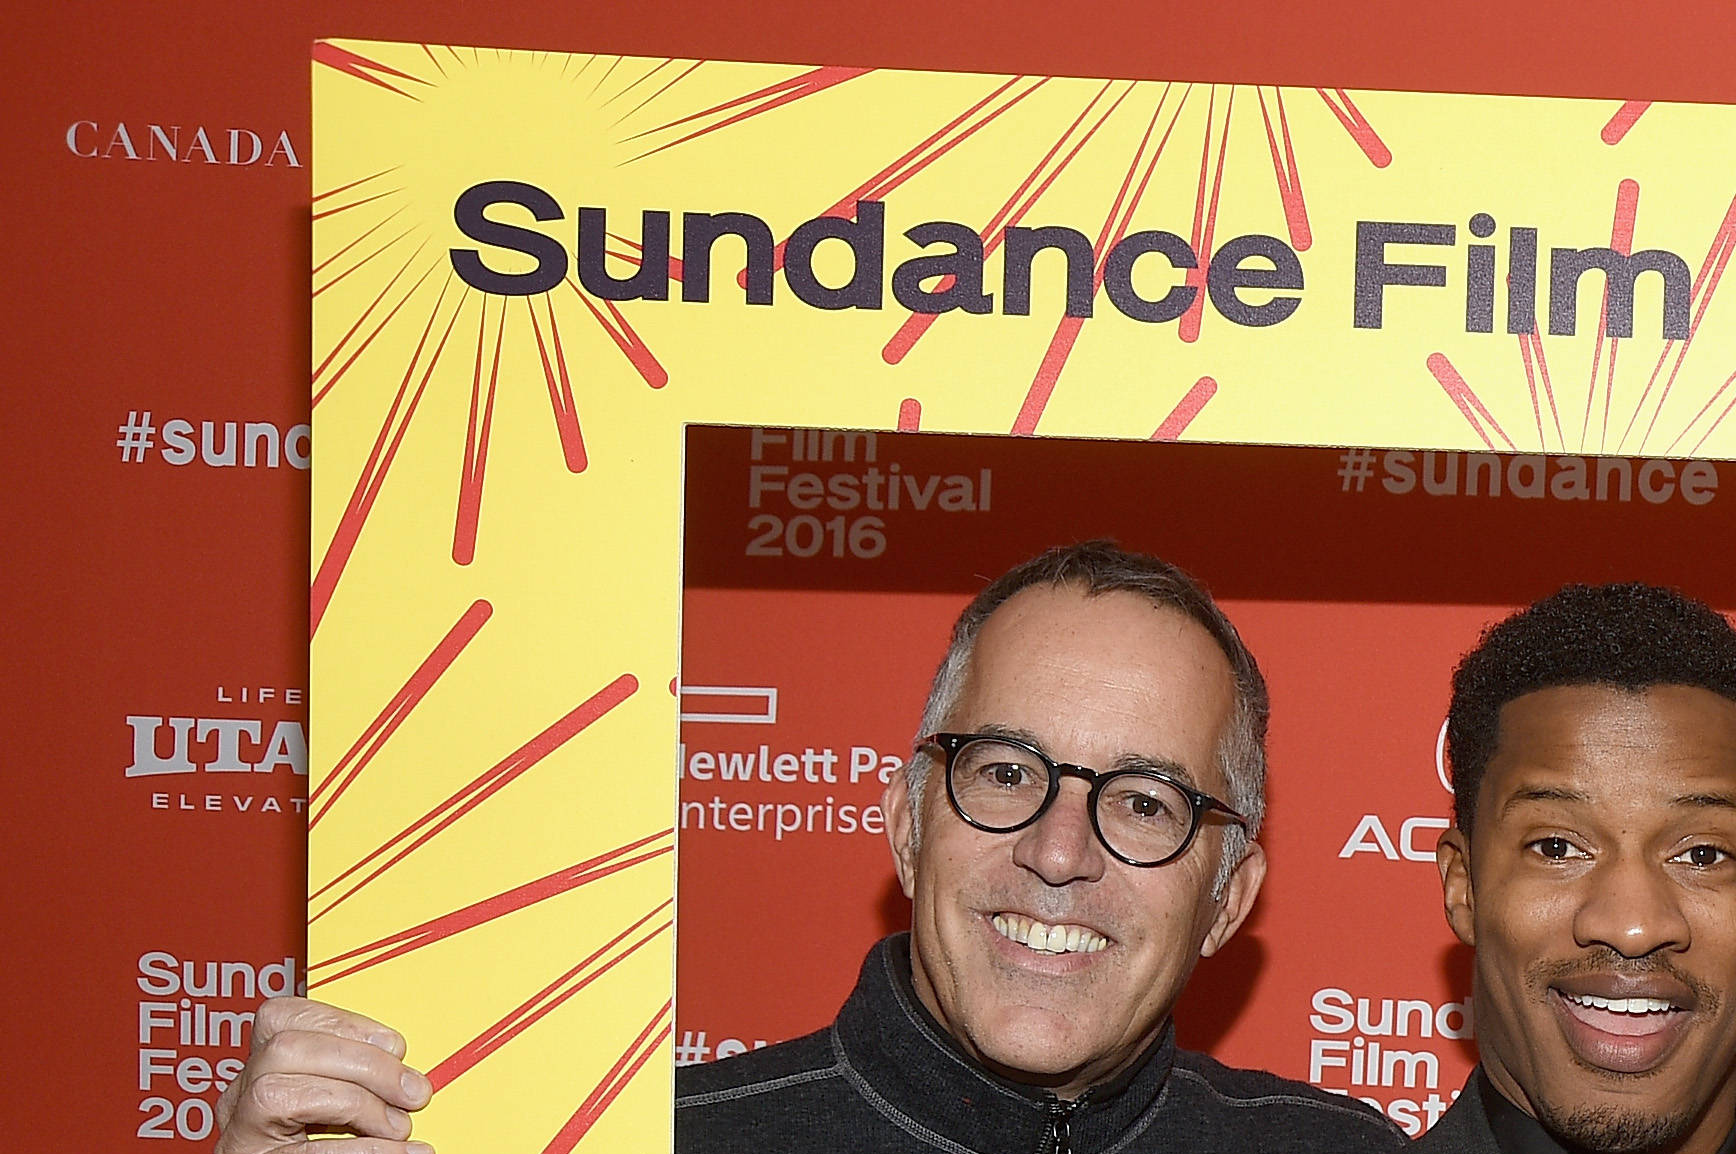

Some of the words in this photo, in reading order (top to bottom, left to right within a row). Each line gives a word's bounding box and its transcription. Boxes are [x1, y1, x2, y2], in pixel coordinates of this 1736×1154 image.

[65, 120, 303, 168] CANADA
[448, 180, 1306, 329] Sundance
[1353, 212, 1693, 342] Film
[747, 463, 993, 513] Festival
[744, 514, 888, 560] 2016
[217, 687, 302, 704] LIFE
[139, 999, 256, 1048] Film
[1309, 1036, 1439, 1090] Film
